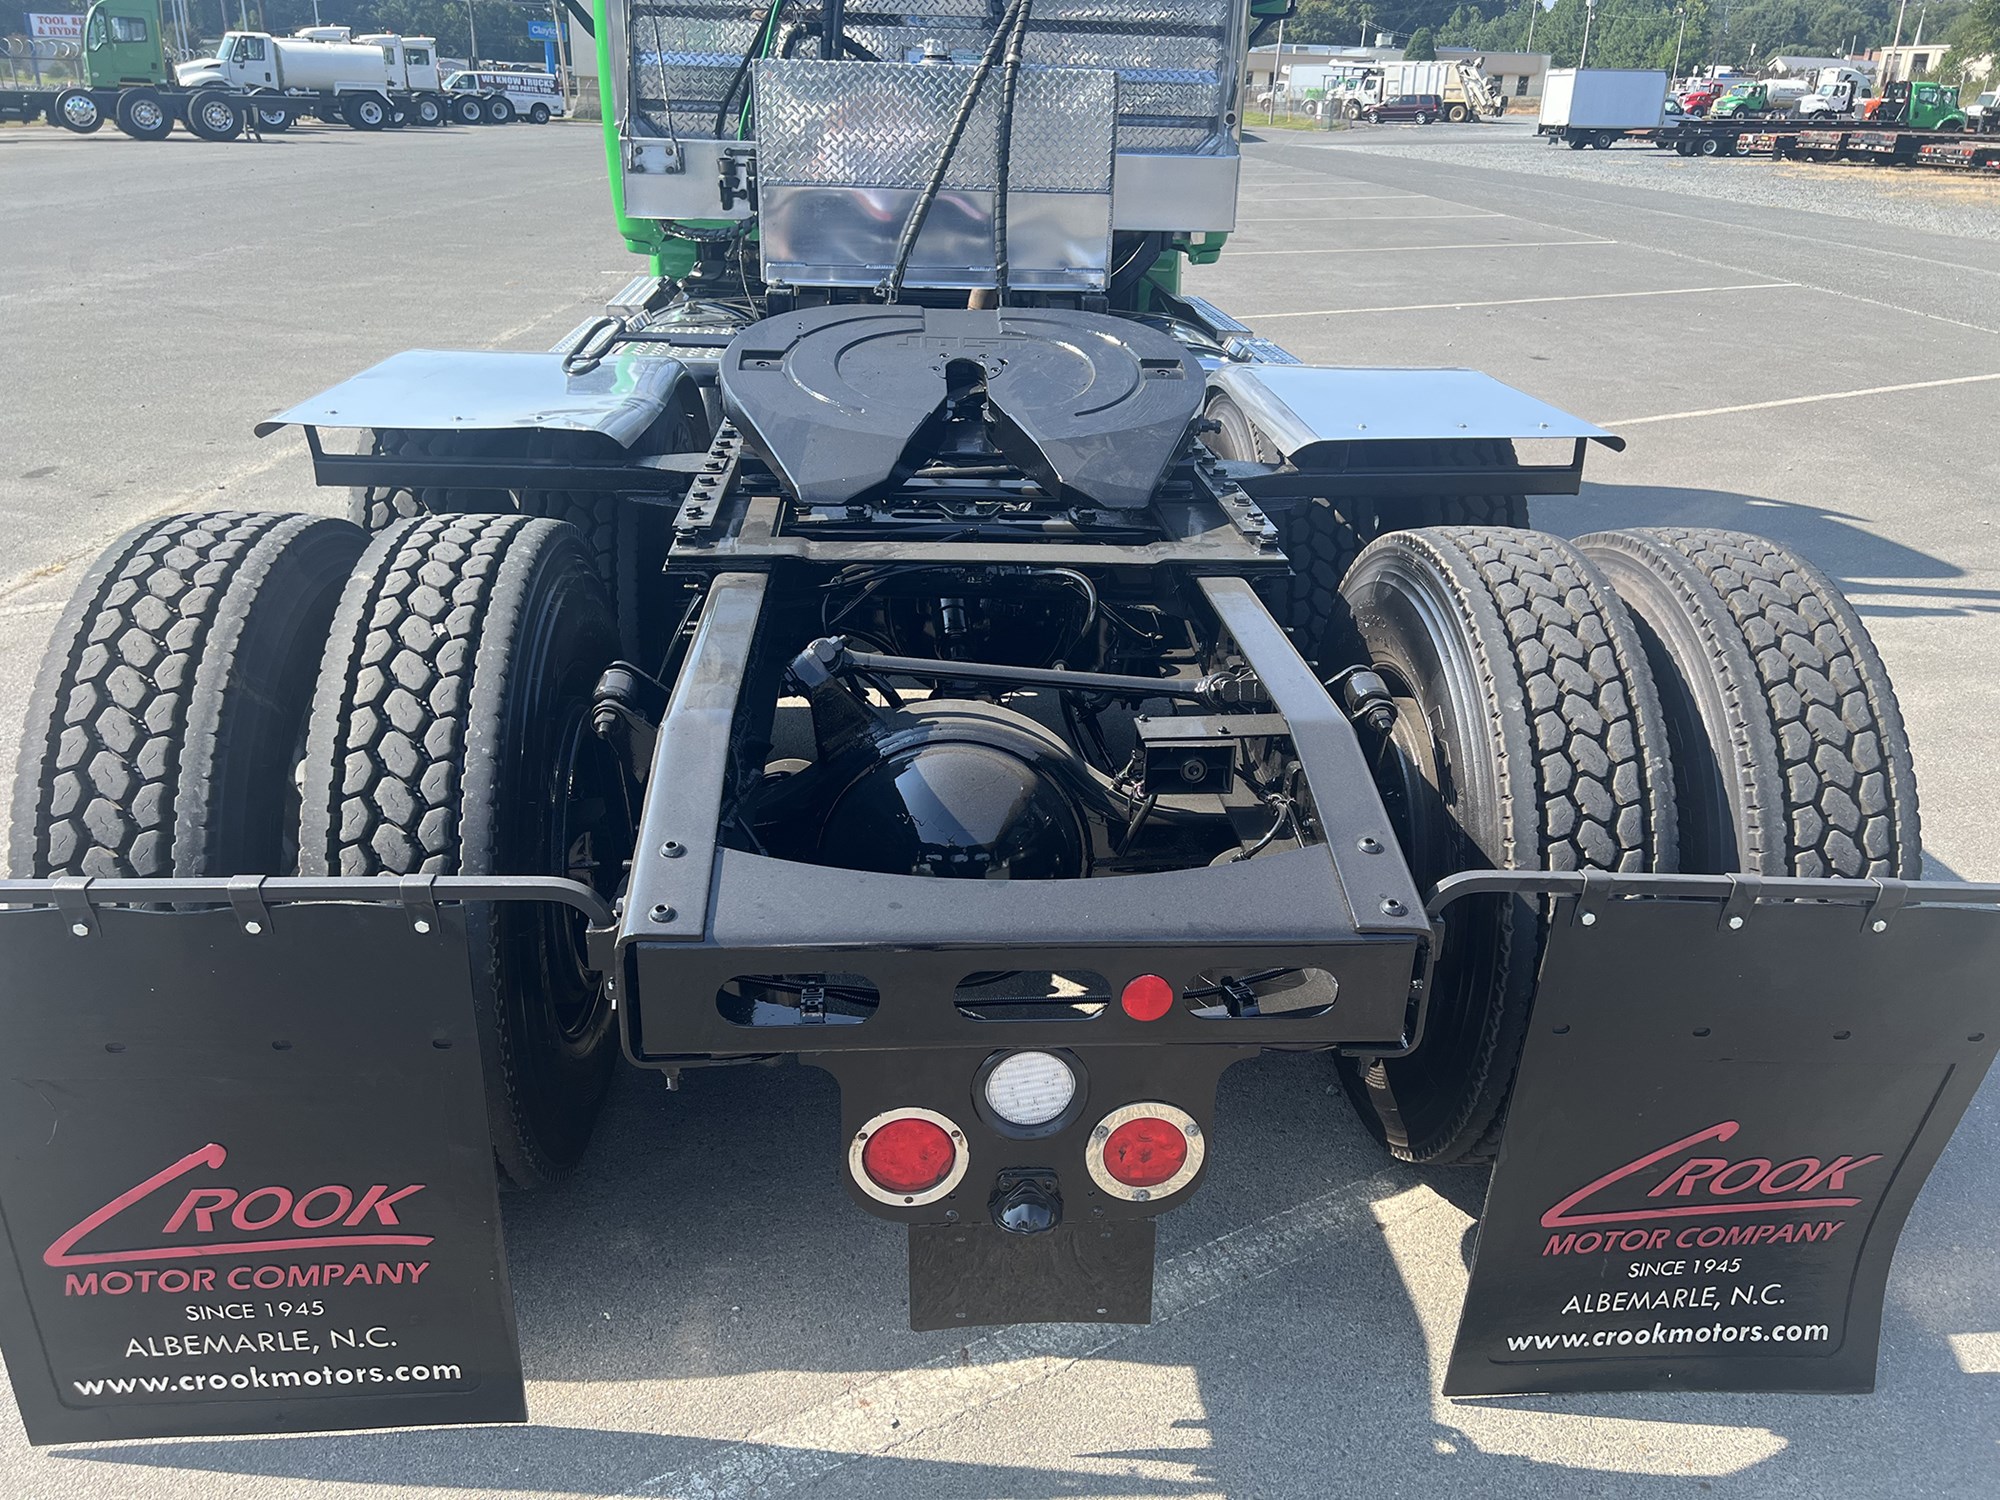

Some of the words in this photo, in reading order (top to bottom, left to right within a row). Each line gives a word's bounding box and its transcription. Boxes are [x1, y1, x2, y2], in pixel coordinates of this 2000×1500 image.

[37, 16, 67, 25] TOOL
[37, 27, 45, 35] &
[481, 75, 495, 84] WE
[495, 76, 520, 85] KNOW
[522, 77, 555, 88] TRUCKS
[1540, 1120, 1884, 1228] CROOK
[43, 1143, 434, 1267] CROOK
[1542, 1228, 1671, 1257] MOTOR
[1675, 1221, 1845, 1249] COMPANY
[65, 1270, 216, 1297] MOTOR
[227, 1262, 430, 1291] COMPANY
[1627, 1260, 1687, 1278] SINCE
[1692, 1257, 1743, 1275] 1945
[185, 1303, 256, 1322] SINCE
[264, 1300, 325, 1318] 1945
[1561, 1286, 1721, 1316] ALBEMARLE,
[1730, 1283, 1786, 1307] N.C.
[125, 1330, 320, 1359] ALBEMARLE,
[330, 1326, 398, 1350] N.C.
[1506, 1321, 1830, 1352] www.crookmotors.com
[73, 1361, 462, 1396] www.crookmotors.com
